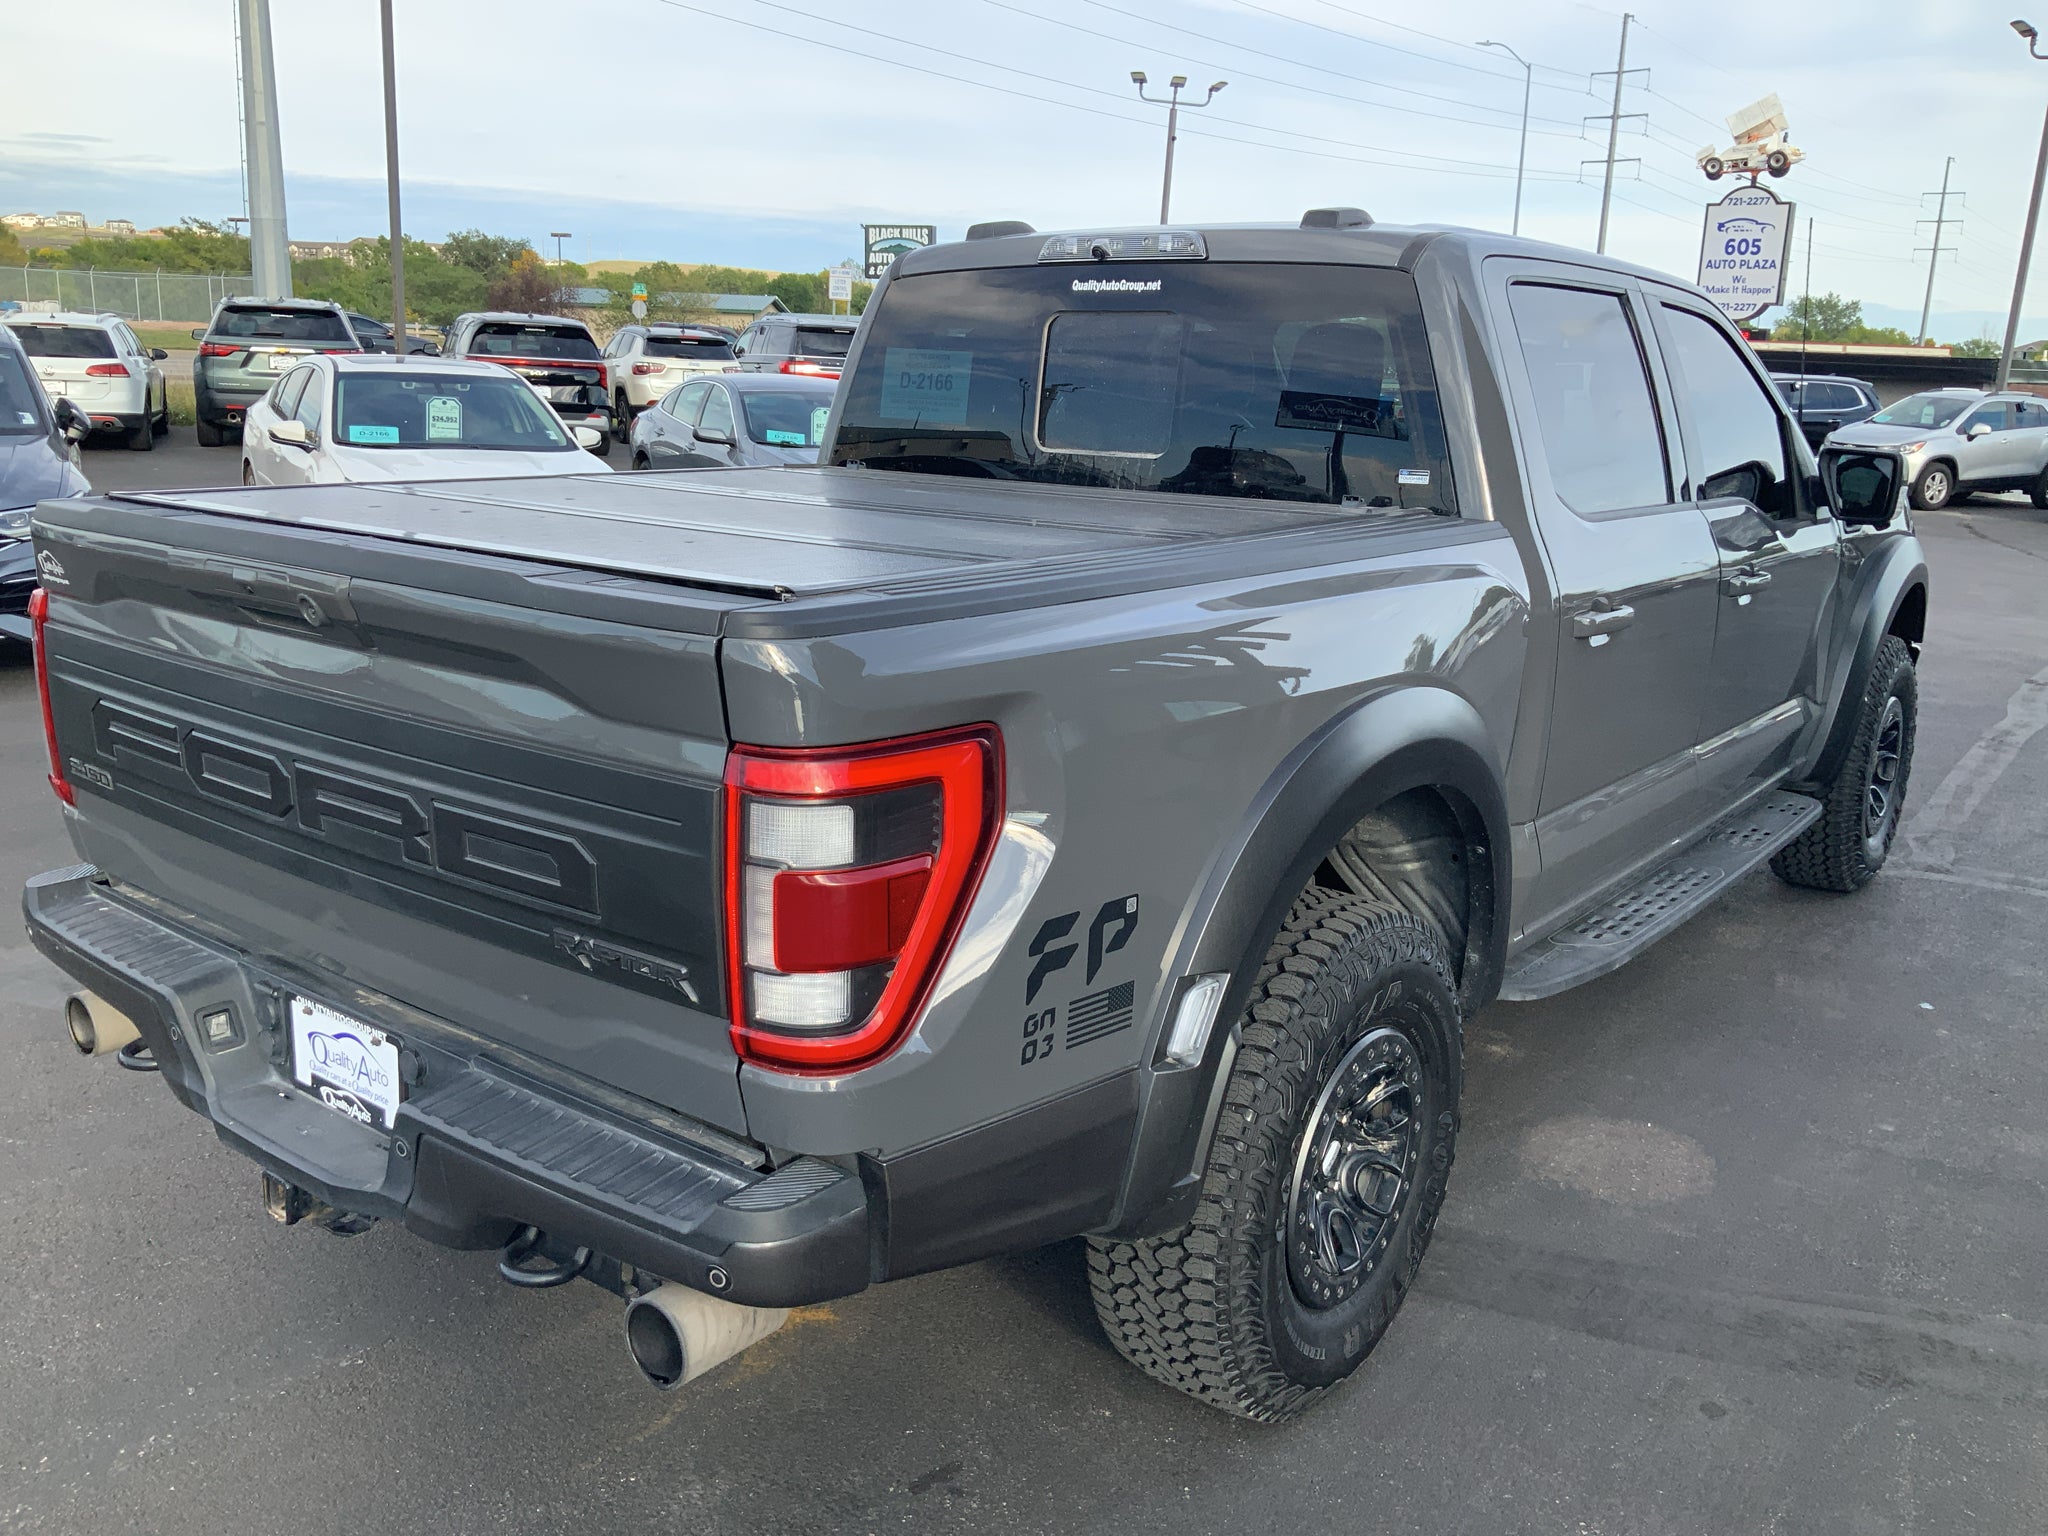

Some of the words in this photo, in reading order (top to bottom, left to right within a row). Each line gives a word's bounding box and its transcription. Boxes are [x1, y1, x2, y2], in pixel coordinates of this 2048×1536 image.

[1727, 196, 1771, 206] 721-2277
[868, 227, 901, 245] BLACK
[902, 227, 929, 245] HILLS
[1724, 238, 1762, 256] 605
[868, 252, 896, 264] AUTO
[1705, 259, 1737, 270] AUTO
[1739, 259, 1777, 270] PLAZA
[1072, 279, 1162, 293] QualityAutoGroup.net
[1732, 275, 1747, 284] We
[1732, 285, 1739, 294] It
[1718, 302, 1758, 312] 21-2277
[900, 371, 954, 392] D-2166
[91, 699, 602, 920] FORD
[552, 926, 701, 1005] RAPTOR
